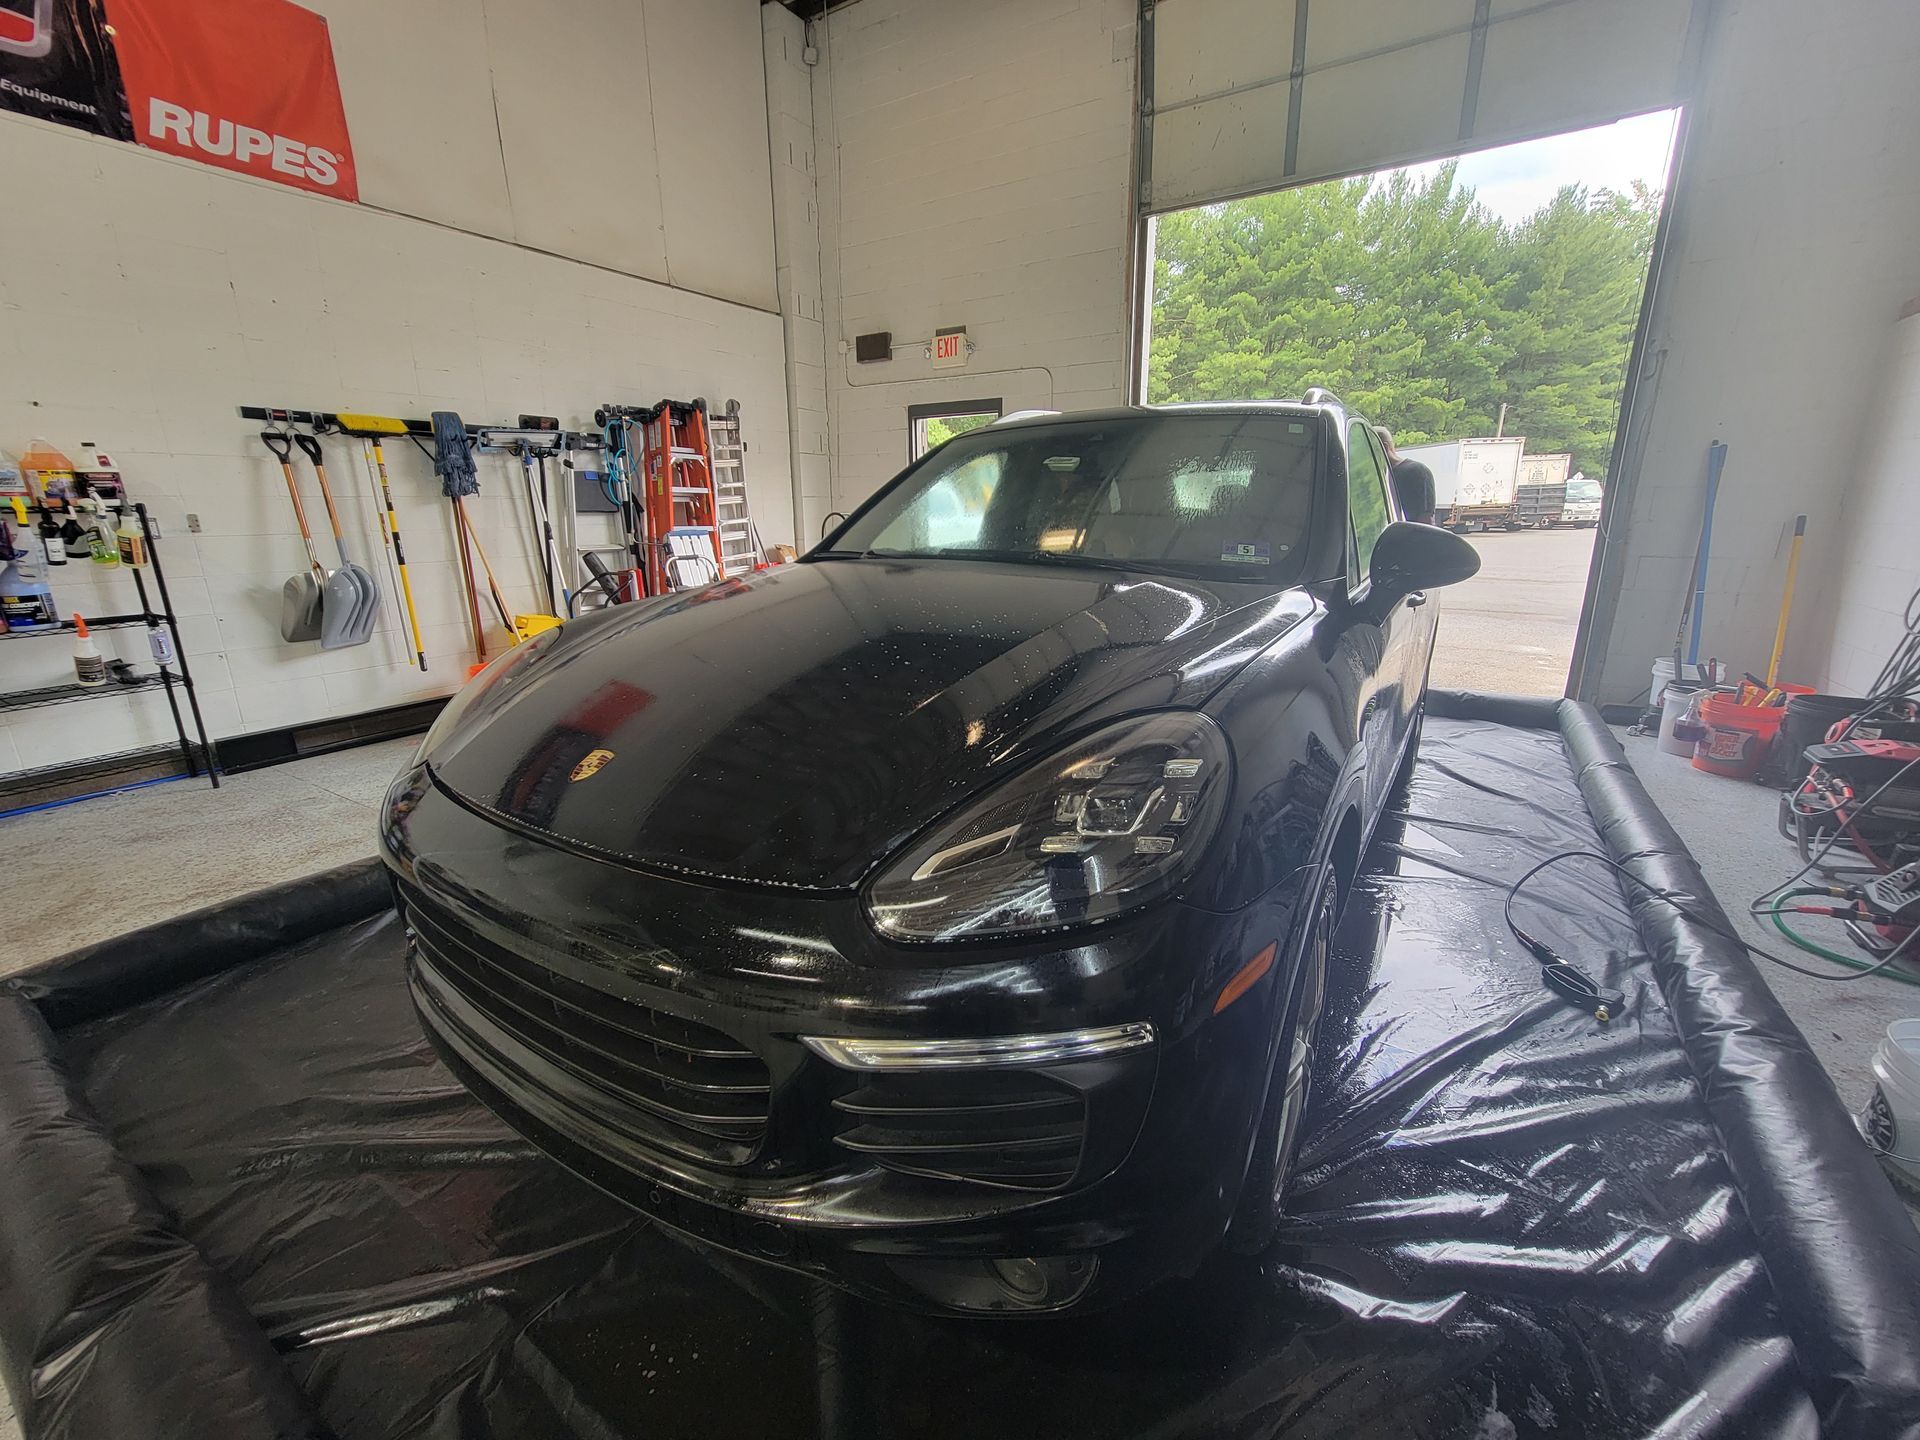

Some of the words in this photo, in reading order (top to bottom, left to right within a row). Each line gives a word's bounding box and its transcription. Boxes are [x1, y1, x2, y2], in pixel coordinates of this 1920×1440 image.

[1, 79, 97, 116] Equipment
[149, 97, 338, 185] RUPES
[937, 336, 960, 359] EXIT
